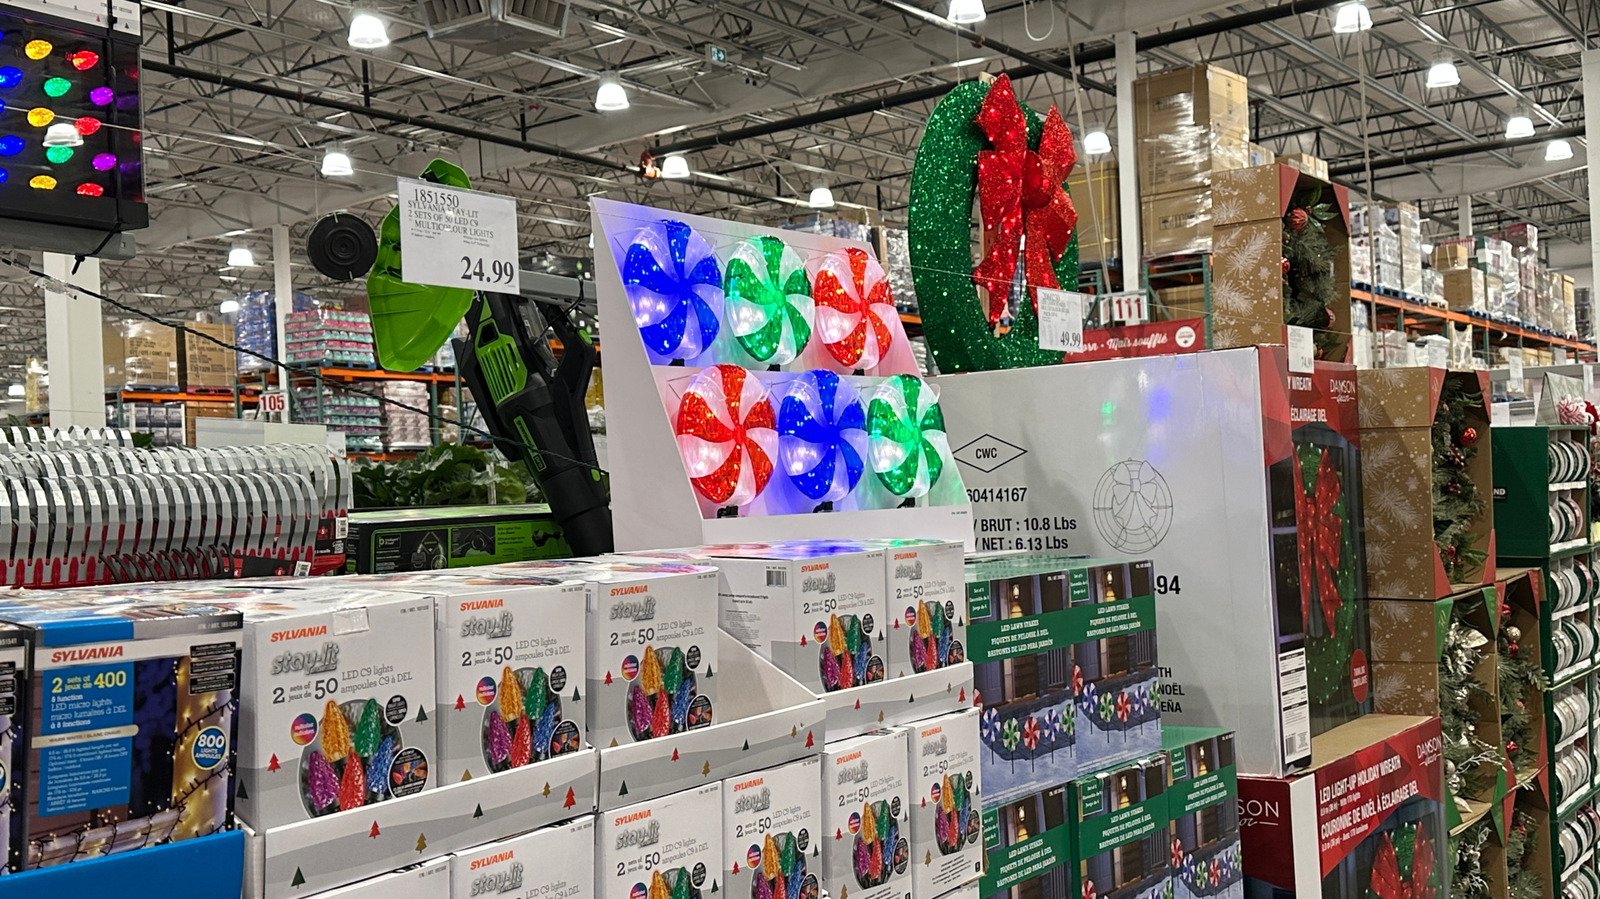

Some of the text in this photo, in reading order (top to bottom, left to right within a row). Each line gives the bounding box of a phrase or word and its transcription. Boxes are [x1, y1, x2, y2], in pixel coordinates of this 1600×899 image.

[414, 188, 459, 208] 1851550
[408, 200, 479, 218] SYLVANIA STAY-LIT
[414, 210, 431, 221] SETS
[433, 213, 443, 222] OF
[454, 216, 468, 225] LED
[415, 220, 494, 239] MULTICOLOUR LIGHTS
[461, 255, 514, 285] 24.99
[1116, 298, 1141, 319] 111
[1060, 331, 1080, 348] 49.99
[260, 395, 285, 411] 105
[975, 447, 998, 459] CWC
[966, 487, 1027, 503] 60414167
[981, 516, 1077, 532] BRUT 10.8 Lbs
[982, 536, 1069, 551] NET 6.13 Lbs
[801, 563, 829, 572] SYLVANIA
[610, 585, 648, 596] SYLVANIA
[913, 585, 923, 598] 50
[460, 599, 504, 611] SYLVANIA
[803, 598, 837, 614] 2 50
[270, 625, 327, 642] SYLVANIA
[610, 632, 618, 646] 2
[638, 627, 655, 645] 50
[657, 622, 669, 631] LED
[51, 646, 123, 663] SYLVANIA
[272, 642, 339, 675] stay-lit
[462, 652, 471, 666] 2
[494, 646, 513, 665] 50
[515, 641, 529, 650] LED
[530, 640, 540, 648] C9
[540, 637, 557, 648] lights
[515, 649, 544, 661] ampoules
[544, 647, 554, 656] C9
[52, 677, 62, 693] 2
[94, 670, 126, 688] 400
[65, 684, 80, 692] jeux
[273, 663, 394, 704] 2 sets of 50 LED C9 lights
[288, 693, 302, 702] jeux
[341, 680, 377, 694] ampoules
[378, 676, 390, 685] C9
[397, 671, 413, 682] DEL
[51, 703, 66, 711] LED
[92, 698, 112, 707] lights
[57, 694, 83, 702] function
[113, 705, 127, 713] DEL
[198, 734, 224, 748] 800
[939, 760, 949, 774] 50
[734, 778, 764, 792] SYLVANIA
[1320, 755, 1401, 804] LED LIGHT-UP HOLIDAY WREATH
[838, 786, 870, 807] 2 50
[614, 809, 652, 827] SYLVANIA
[1321, 811, 1352, 839] COURONNE
[1353, 806, 1360, 824] DE
[1361, 799, 1376, 820] NOËL
[1382, 784, 1409, 810] ÉCLAIRAGE
[1409, 780, 1419, 796] DEL
[736, 816, 772, 838] 2 50
[470, 850, 514, 871] SYLVANIA
[617, 862, 626, 876] 2
[645, 851, 660, 871] 50
[662, 844, 673, 854] LED
[526, 888, 539, 899] LED
[540, 884, 550, 895] C9
